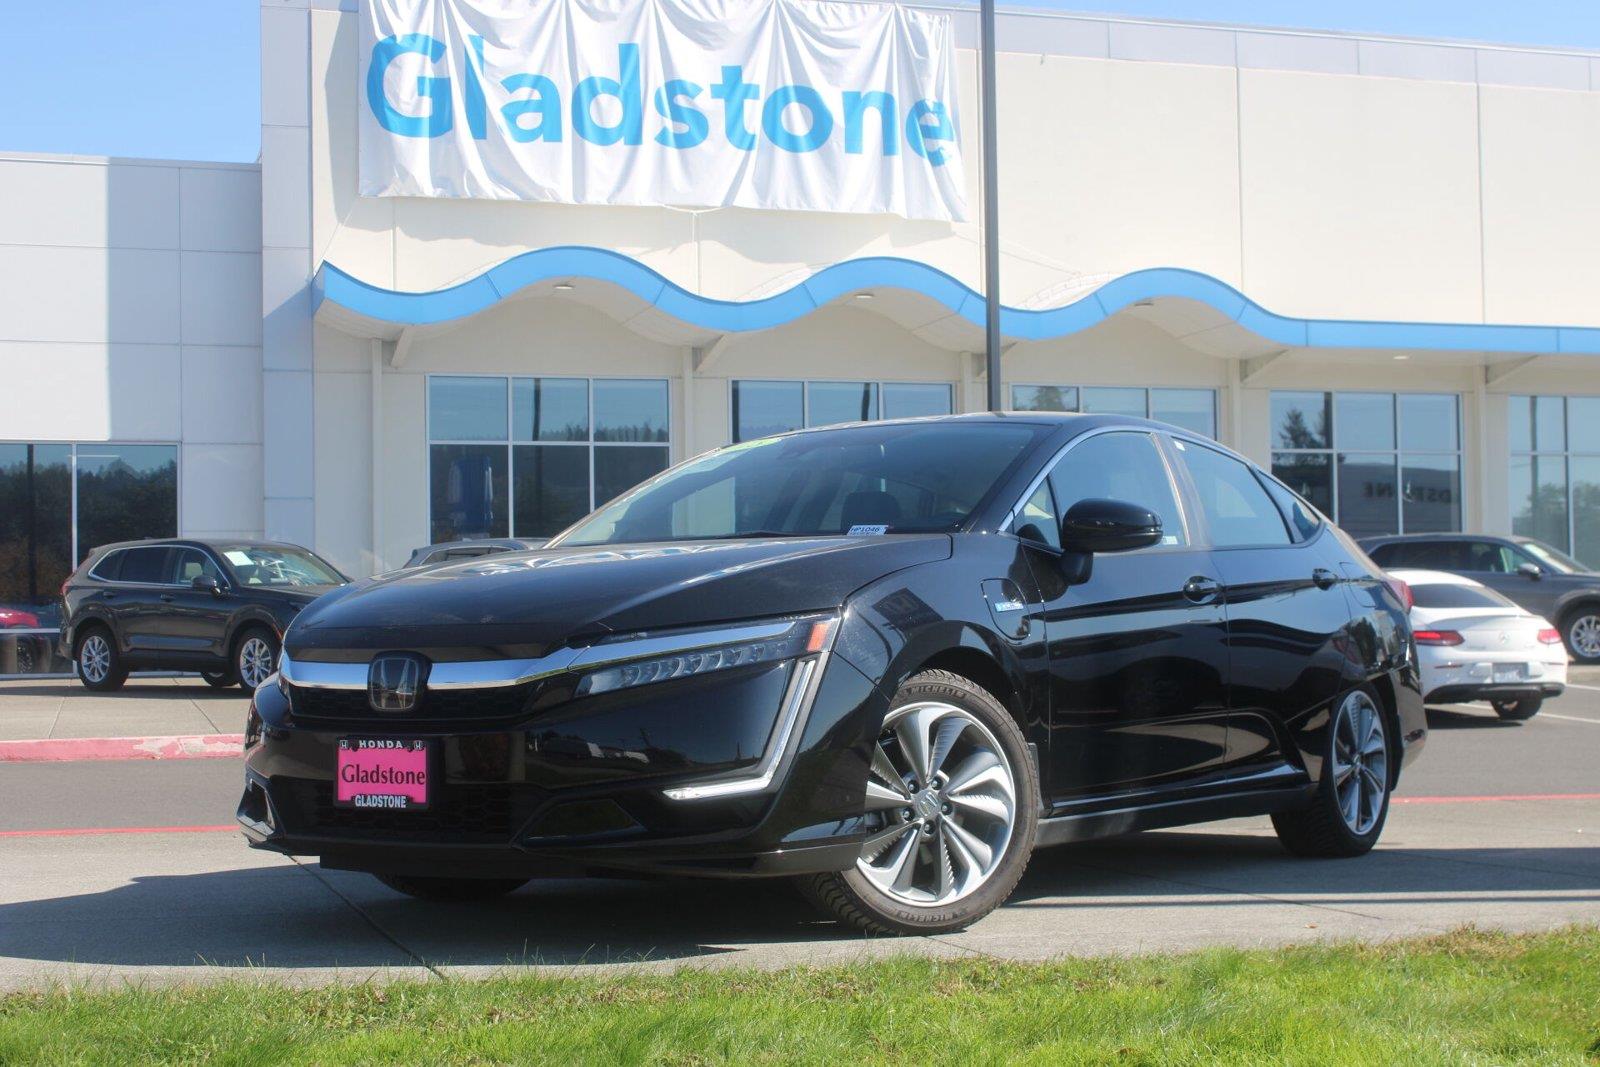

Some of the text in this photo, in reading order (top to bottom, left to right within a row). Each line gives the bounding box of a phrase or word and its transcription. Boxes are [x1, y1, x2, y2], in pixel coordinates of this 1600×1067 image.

[365, 32, 957, 167] Gladstone
[910, 684, 966, 699] MICHELIN
[358, 740, 404, 749] HONDA
[341, 764, 426, 785] Gladstone
[354, 794, 407, 809] GLADSTONE
